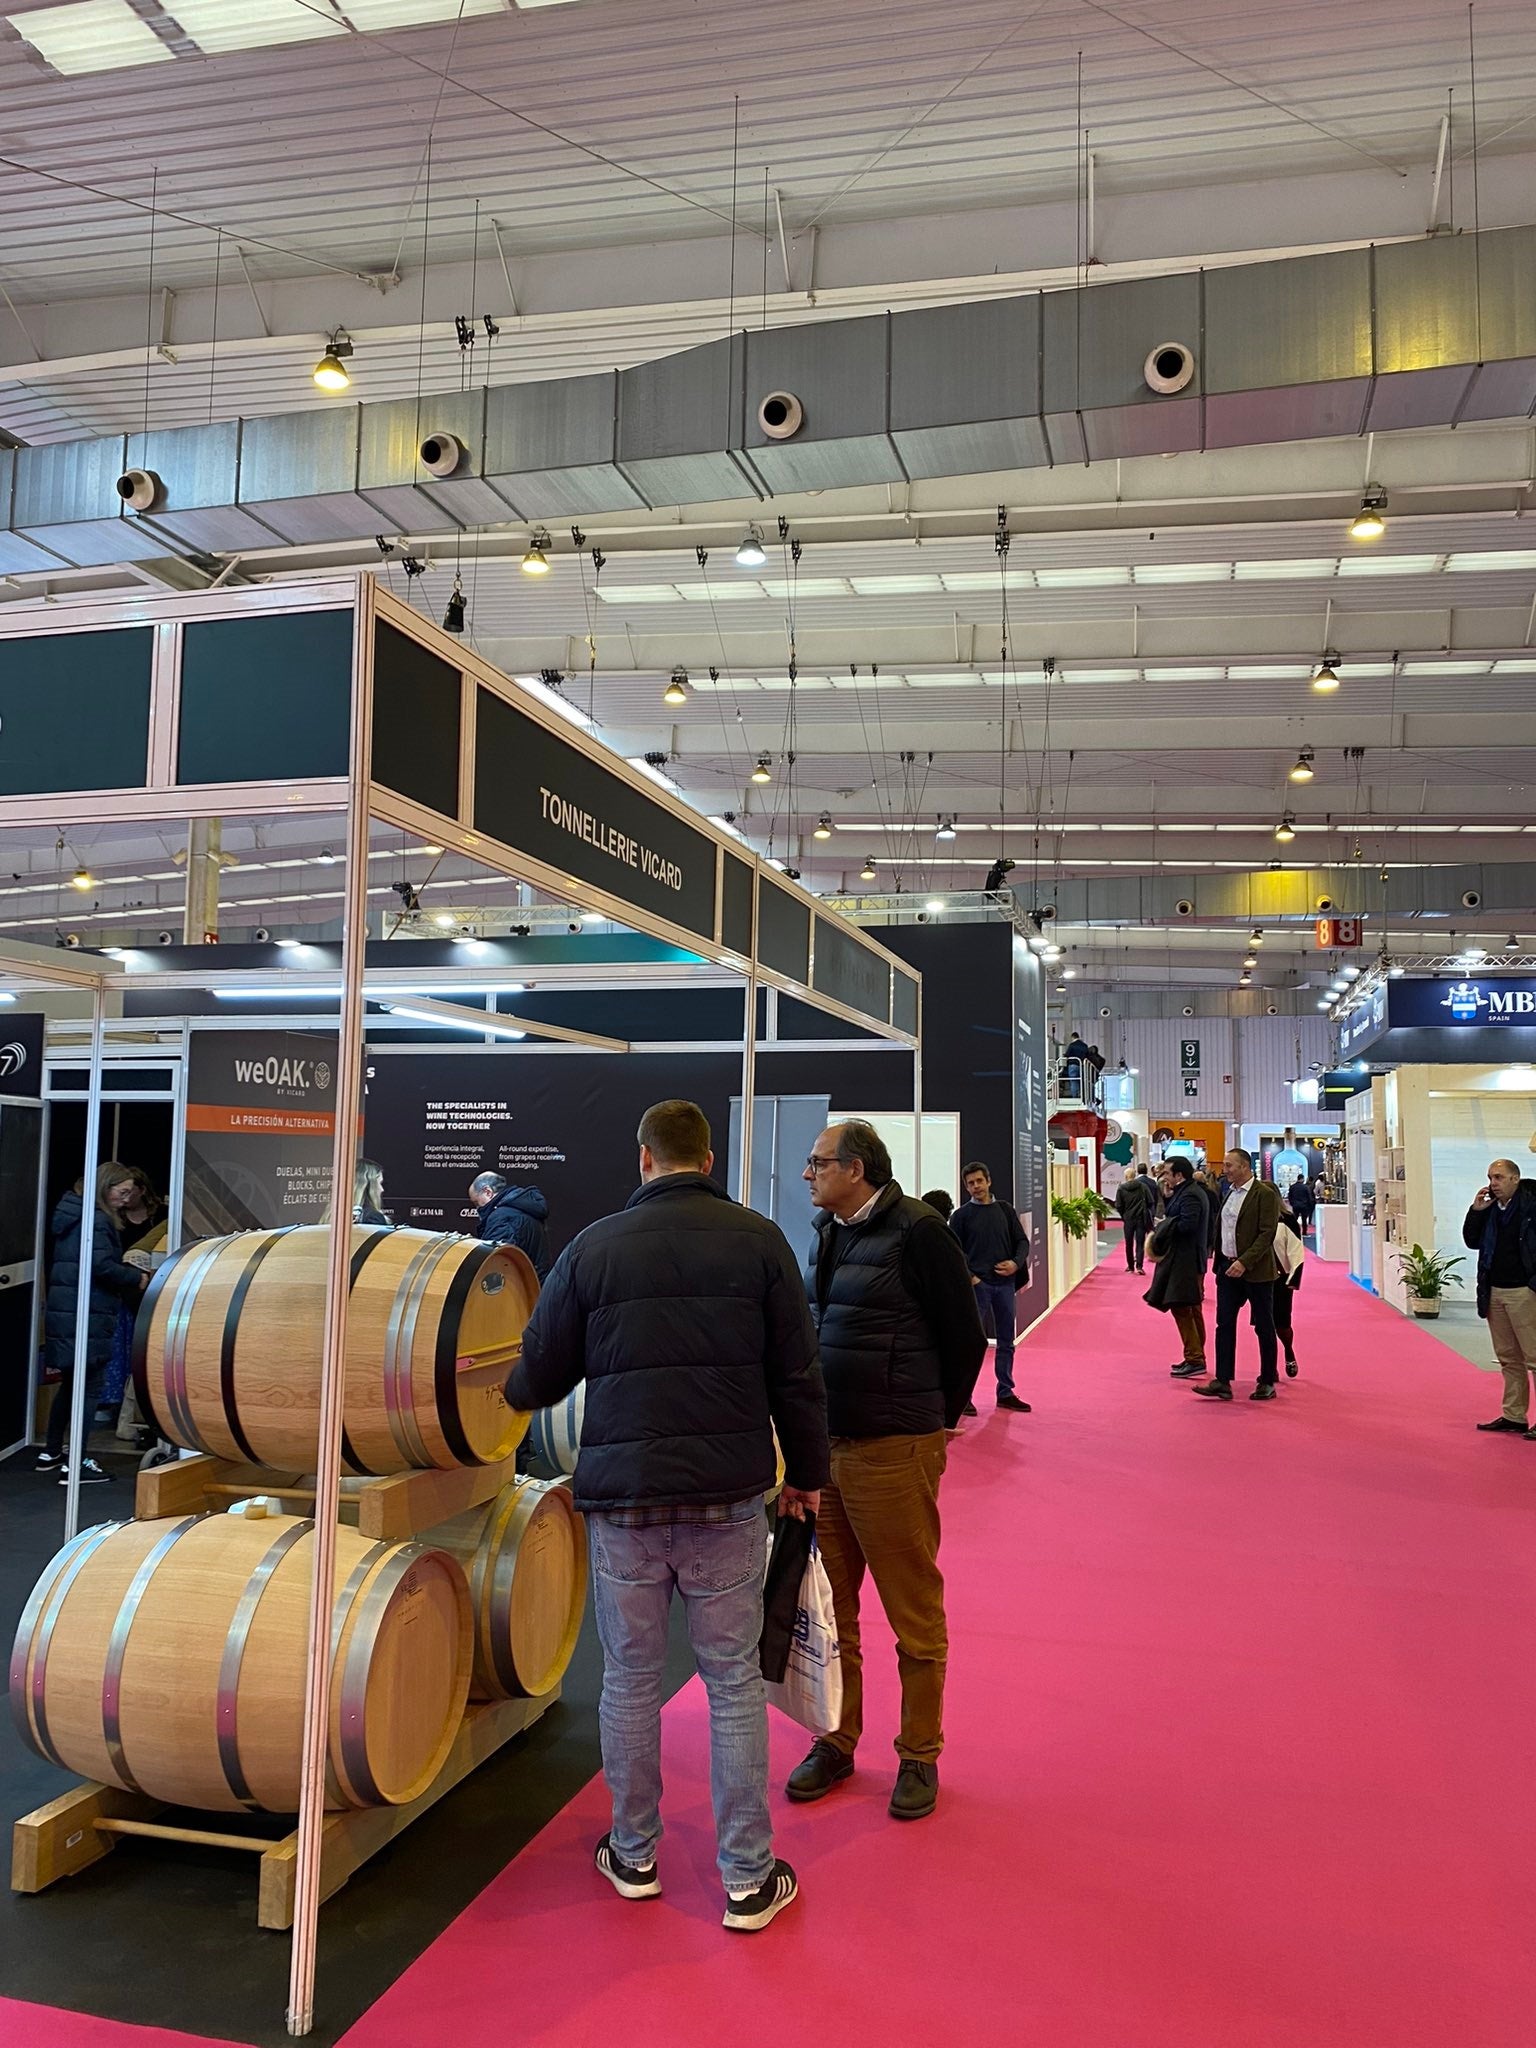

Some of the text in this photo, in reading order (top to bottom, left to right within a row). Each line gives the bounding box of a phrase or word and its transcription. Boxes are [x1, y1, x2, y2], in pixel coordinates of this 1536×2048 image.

[540, 786, 682, 891] TONNELLERIE VICARD
[1320, 919, 1329, 945] 8
[1339, 919, 1355, 942] 8
[1488, 991, 1536, 1013] MB
[1185, 1044, 1195, 1057] 9
[426, 1102, 507, 1110] THE SPECIALISTS IN
[426, 1112, 513, 1120] WINE TECHNOLOGIES.
[231, 1114, 329, 1129] LA PRECISIÓN ALTERNATIVA
[426, 1122, 491, 1130] NOW TOGETHER
[425, 1145, 459, 1153] Experiencia
[450, 1153, 481, 1162] recepción
[537, 1153, 566, 1162] receiving
[276, 1166, 335, 1177] DUELAS, MINI DUE
[288, 1180, 333, 1191] BLOCKS, CHIP
[308, 1193, 317, 1203] DE
[419, 1208, 444, 1216] GIMAR
